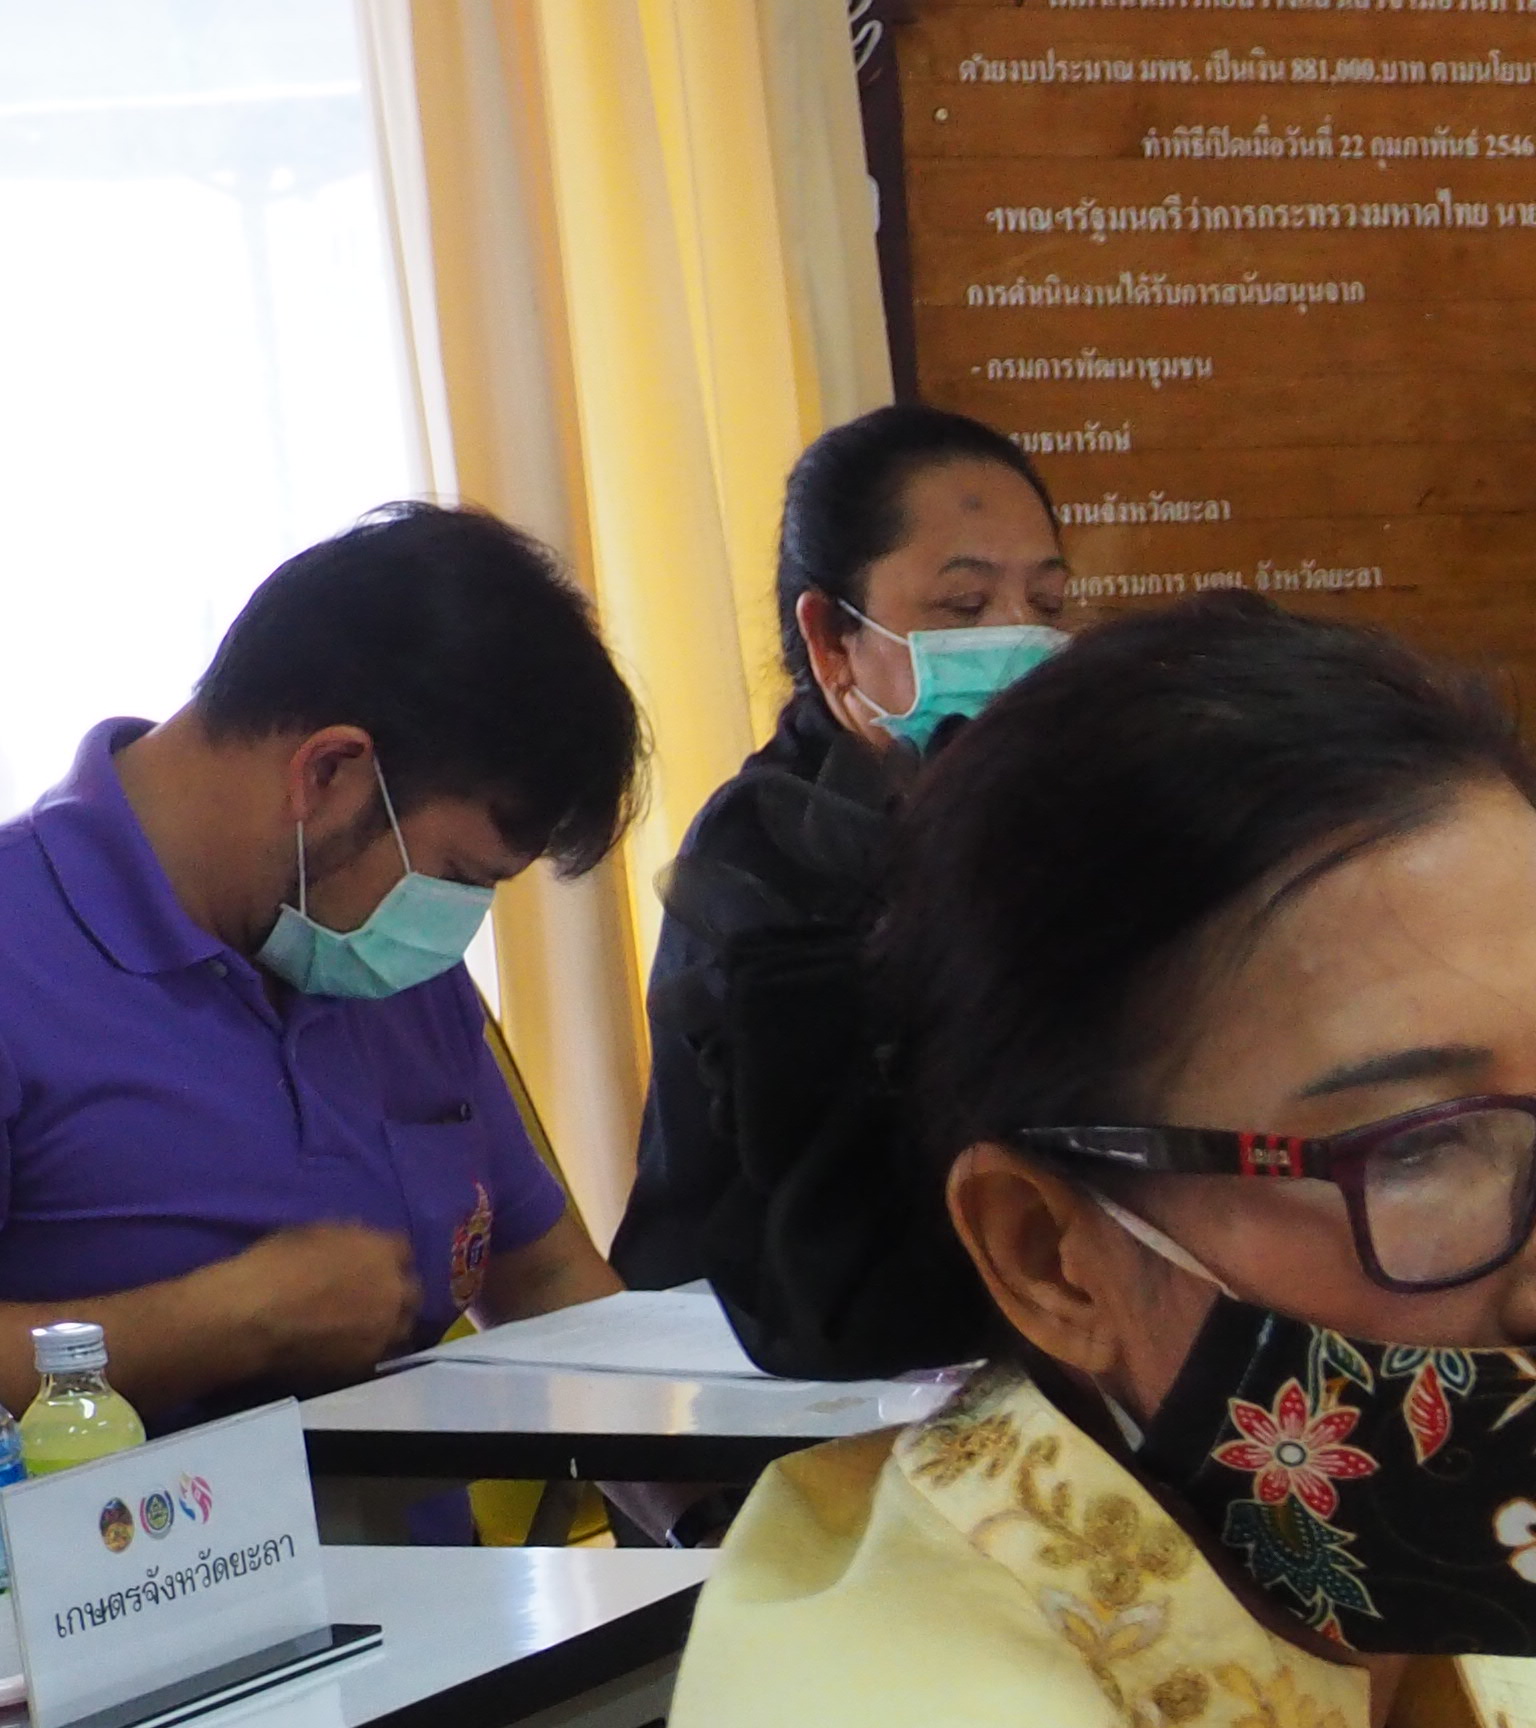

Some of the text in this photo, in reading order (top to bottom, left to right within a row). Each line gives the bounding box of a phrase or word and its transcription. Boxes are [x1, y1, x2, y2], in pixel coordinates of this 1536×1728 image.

[1340, 134, 1365, 160] 22
[1484, 134, 1536, 159] 2546
[987, 346, 1213, 390] กรมการพัฒนาชุมชน
[1056, 490, 1232, 526] งานจังหวัดยะลา
[54, 1532, 296, 1638] เกษตรจังหวัดยะลา
